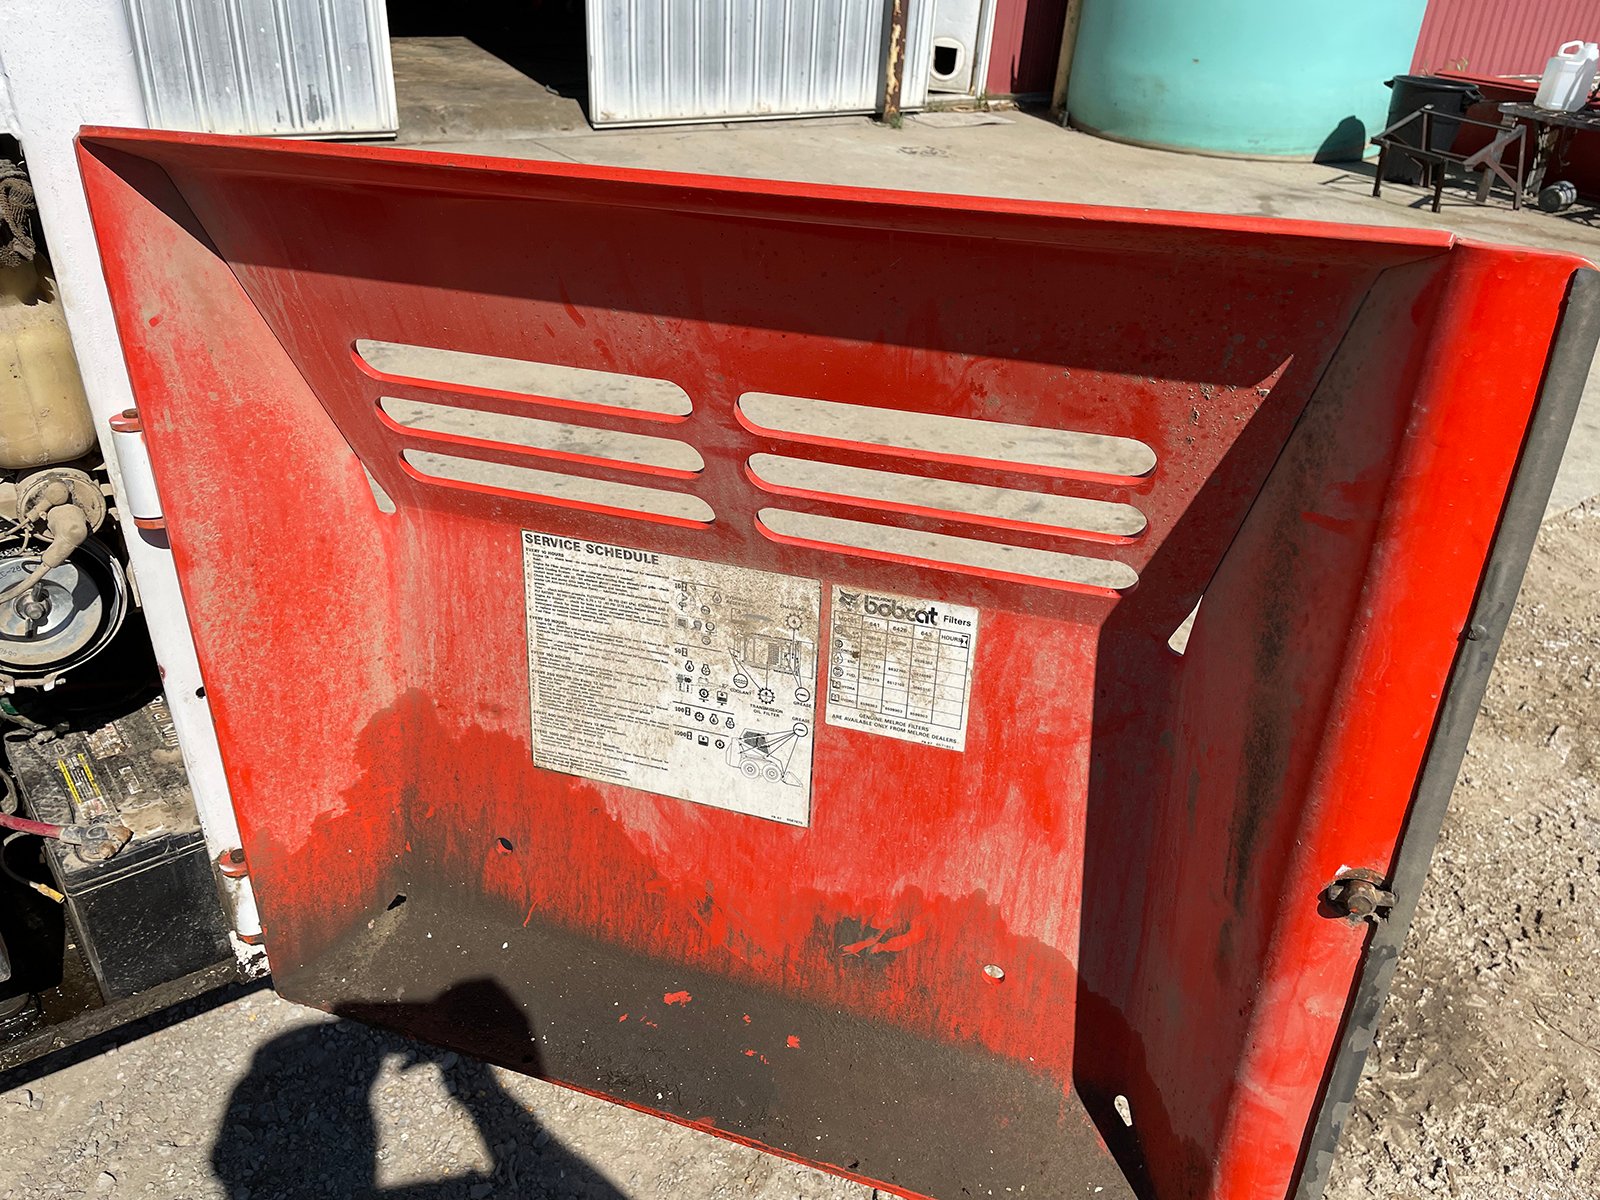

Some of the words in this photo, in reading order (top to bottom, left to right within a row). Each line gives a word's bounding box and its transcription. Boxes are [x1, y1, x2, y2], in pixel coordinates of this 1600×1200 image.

[524, 533, 580, 551] SERVICE
[585, 543, 658, 564] SCHEDULE
[863, 594, 938, 625] bobcat
[943, 614, 971, 626] Filters
[941, 634, 961, 642] HOURS
[729, 687, 751, 695] COOLANT
[750, 703, 783, 714] TRANSMISSION
[844, 715, 872, 725] AVAILABLE
[907, 729, 929, 738] MELROE
[931, 734, 956, 743] DEALERS
[858, 713, 881, 721] GENUINE
[884, 718, 905, 726] MELROE
[908, 723, 928, 731] FILTERS
